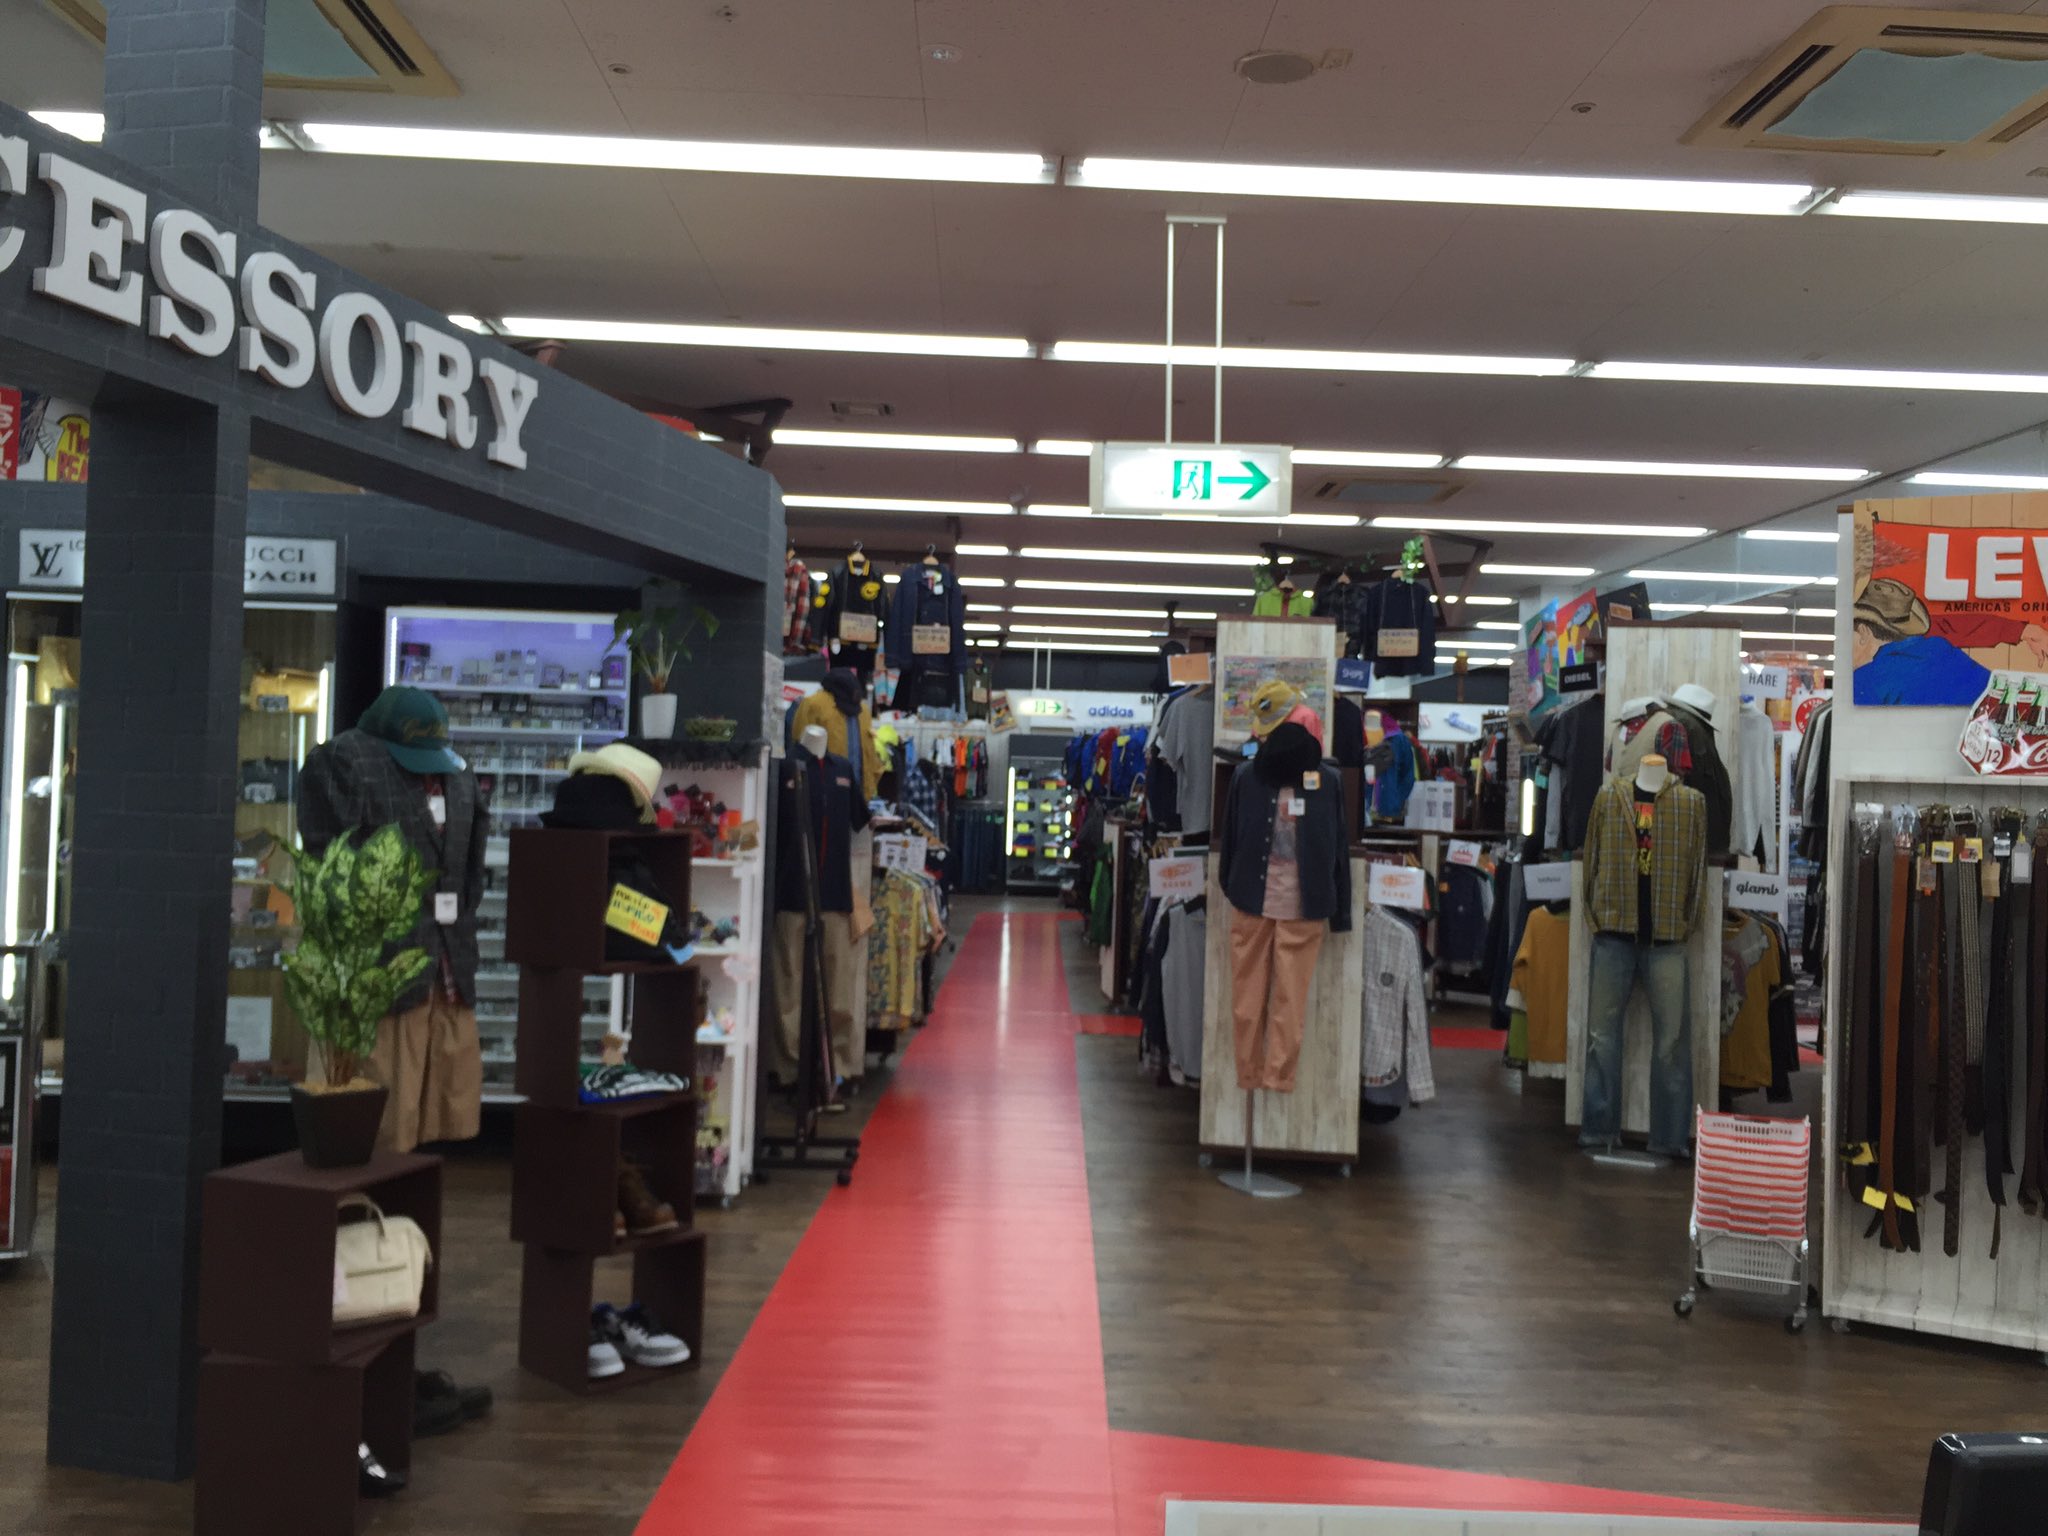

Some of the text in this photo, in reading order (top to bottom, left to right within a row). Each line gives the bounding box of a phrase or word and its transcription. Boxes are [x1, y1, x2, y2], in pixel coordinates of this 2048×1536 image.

[1749, 672, 1778, 687] HARE
[1088, 705, 1134, 718] adidas
[1987, 749, 2001, 763] 12
[1736, 881, 1779, 897] glamb
